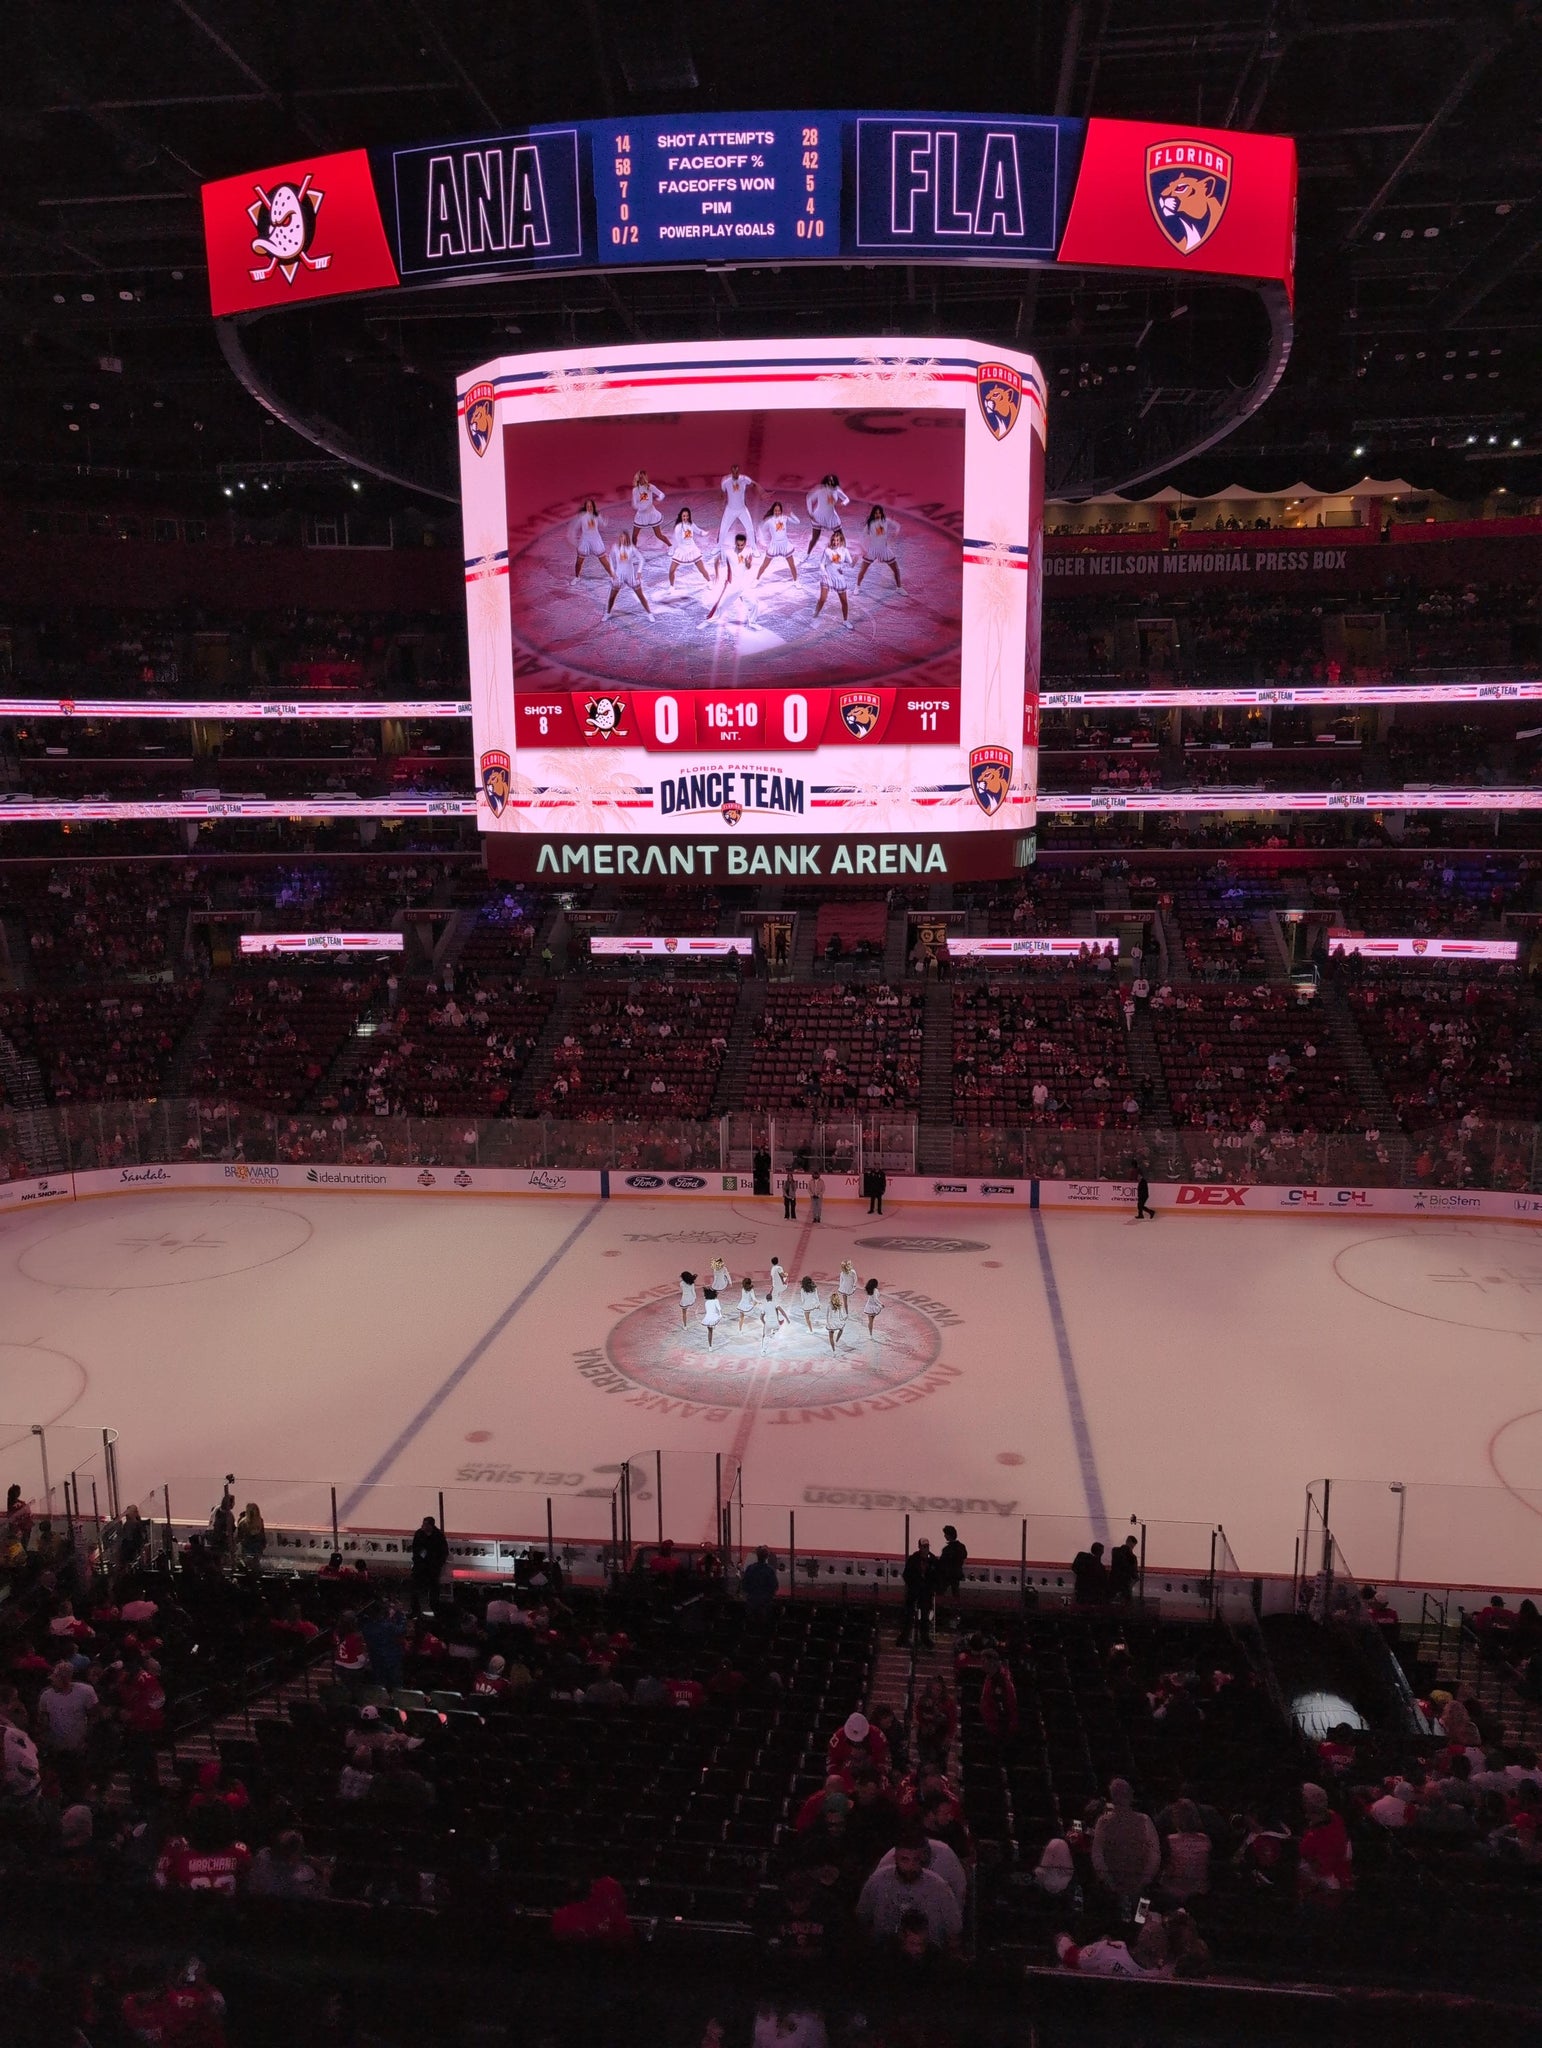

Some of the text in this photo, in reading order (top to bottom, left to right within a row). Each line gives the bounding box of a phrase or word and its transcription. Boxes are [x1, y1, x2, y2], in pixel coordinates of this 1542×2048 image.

[615, 135, 630, 153] 14
[657, 131, 775, 148] SHOT ATTEMPTS
[802, 128, 818, 146] 28
[615, 158, 631, 176] 58
[668, 155, 764, 170] FACEOFF %
[802, 151, 818, 169] 42
[1154, 149, 1225, 173] FLORIDA
[619, 181, 628, 198] 7
[658, 178, 775, 194] FACEOFFS WON
[806, 175, 814, 192] 5
[891, 131, 1024, 236] FLA
[427, 145, 550, 258] ANA
[702, 202, 732, 214] PIM
[805, 197, 814, 214] 4
[620, 204, 629, 221] 0
[612, 226, 639, 244] 0/2
[659, 223, 775, 239] POWER PLAY GOALS
[796, 220, 824, 239] 0/0
[981, 367, 1018, 386] FLORIDA
[1043, 550, 1347, 577] OGER NEILSON MEMORIAL PRESS BOX
[842, 694, 877, 704] FLORIDA
[907, 701, 950, 711] SHOTS
[524, 706, 562, 715] SHOTS
[705, 702, 758, 727] 16:10
[783, 694, 808, 743] 0
[539, 717, 548, 734] 8
[654, 696, 679, 744] 0
[920, 712, 937, 731] 11
[720, 731, 741, 741] INT.
[483, 754, 508, 768] FLORIDA
[973, 751, 1009, 763] FLORIDA
[680, 764, 783, 774] FLORIDA PANTHERS
[660, 772, 804, 815] DANCE TEAM
[536, 843, 948, 875] AMERANT BANK ARENA
[307, 936, 341, 947] DANCE TEAM
[1013, 941, 1049, 952] DANCE TEAM
[120, 1168, 169, 1182] Sandals
[225, 1165, 279, 1178] BROWARD
[777, 1179, 808, 1189] Hlth
[1175, 1185, 1250, 1206] DEX
[1430, 1194, 1481, 1206] BioStem
[889, 1288, 966, 1328] ARENA
[572, 1347, 640, 1396] ARENA
[455, 1469, 585, 1487] CELSIUS
[804, 1488, 1018, 1516] AutoNation
